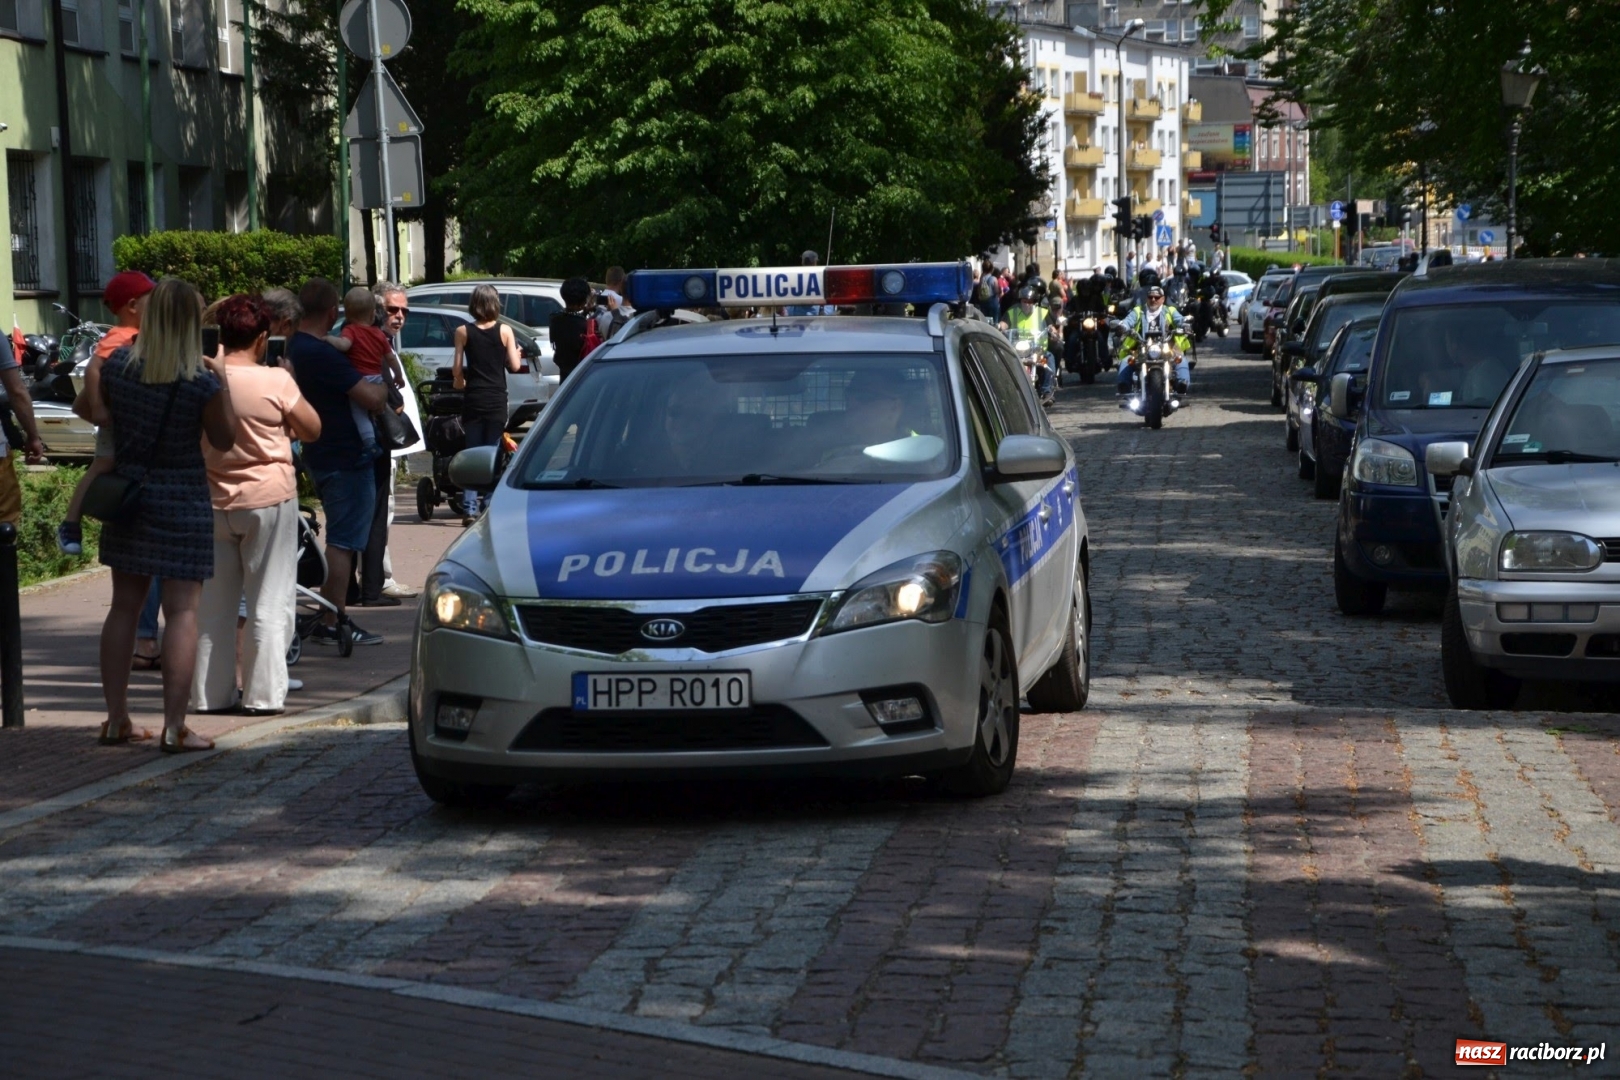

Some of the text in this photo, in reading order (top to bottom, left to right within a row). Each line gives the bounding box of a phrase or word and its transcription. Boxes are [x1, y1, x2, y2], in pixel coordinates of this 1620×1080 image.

[719, 273, 821, 299] POLICJA
[557, 547, 785, 583] POLICJA
[648, 623, 677, 635] KIA
[576, 696, 587, 705] PL
[592, 676, 743, 708] HPP R010
